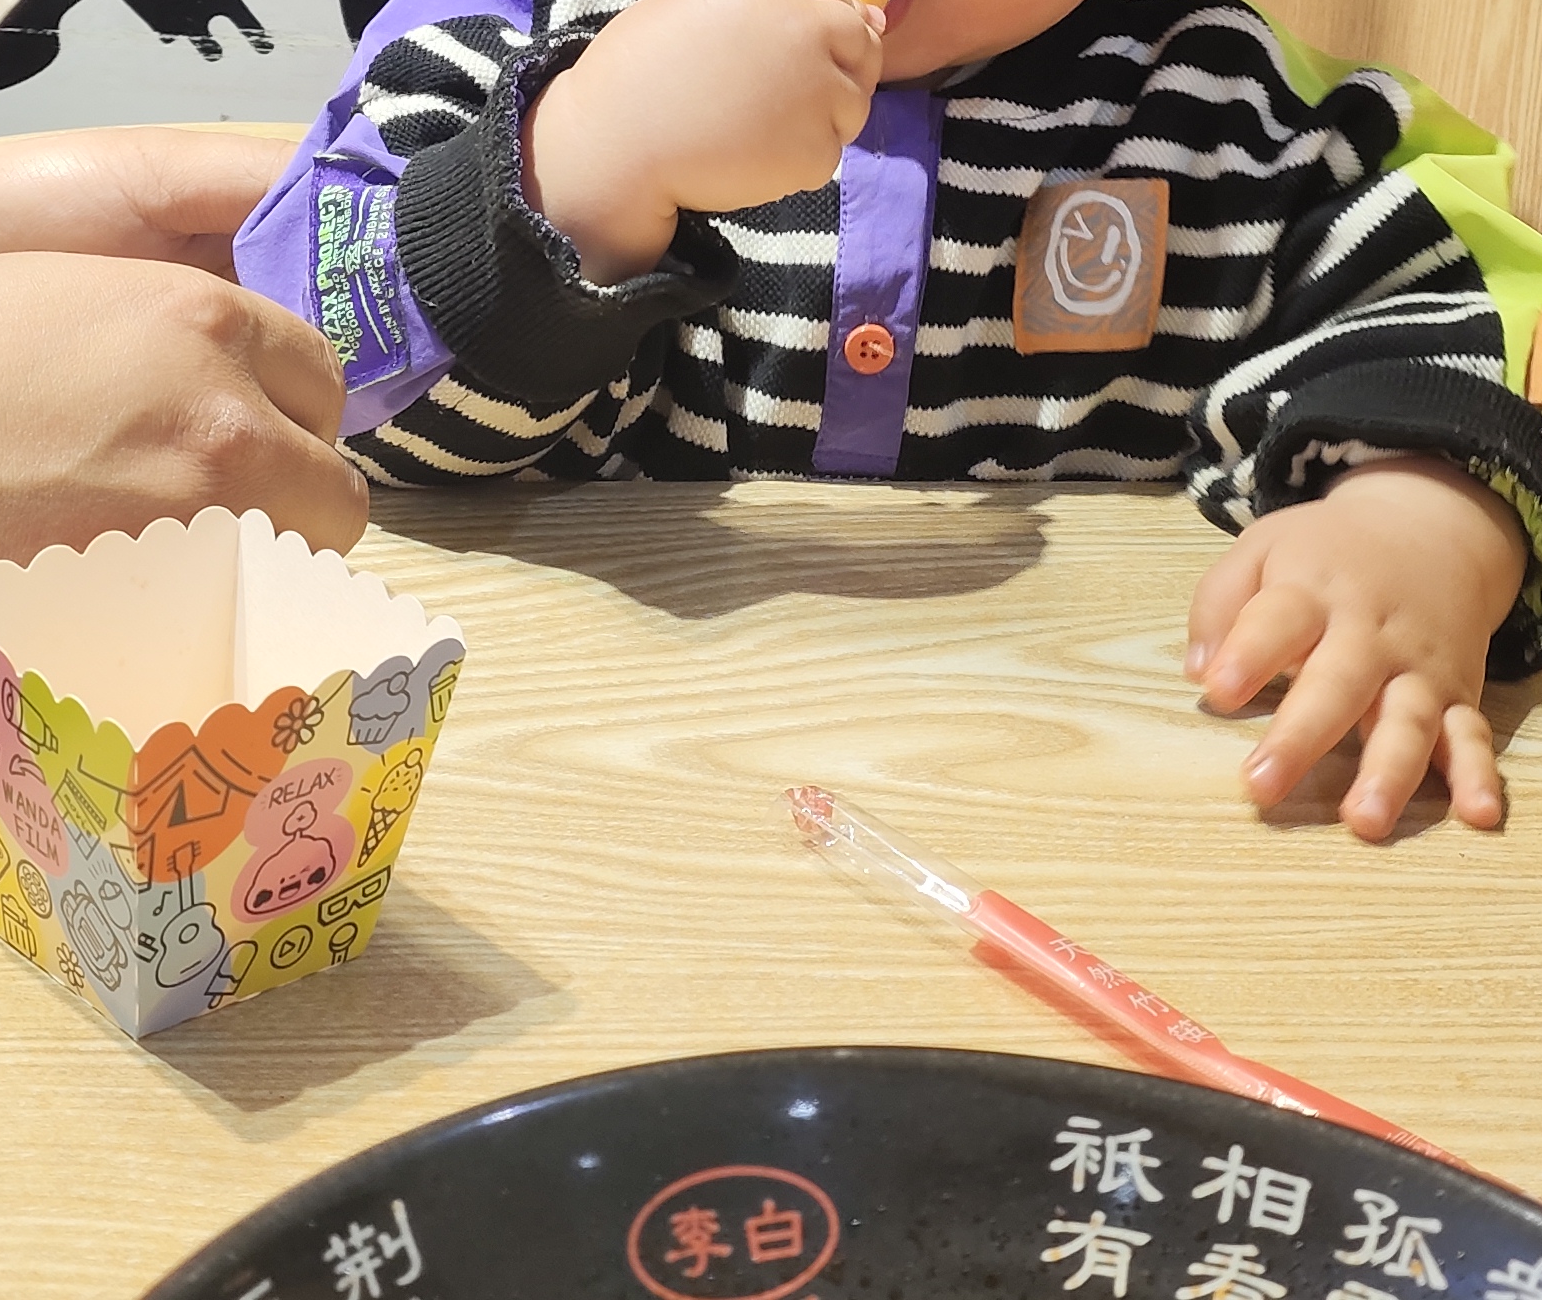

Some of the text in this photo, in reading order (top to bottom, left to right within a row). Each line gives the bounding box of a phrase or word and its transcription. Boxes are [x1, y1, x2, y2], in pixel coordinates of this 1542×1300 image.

[2, 779, 62, 841] WANDA
[269, 767, 336, 809] RELAX
[13, 813, 59, 867] FILM
[1049, 937, 1216, 1044] 天然竹筷
[664, 1198, 804, 1279] 李白
